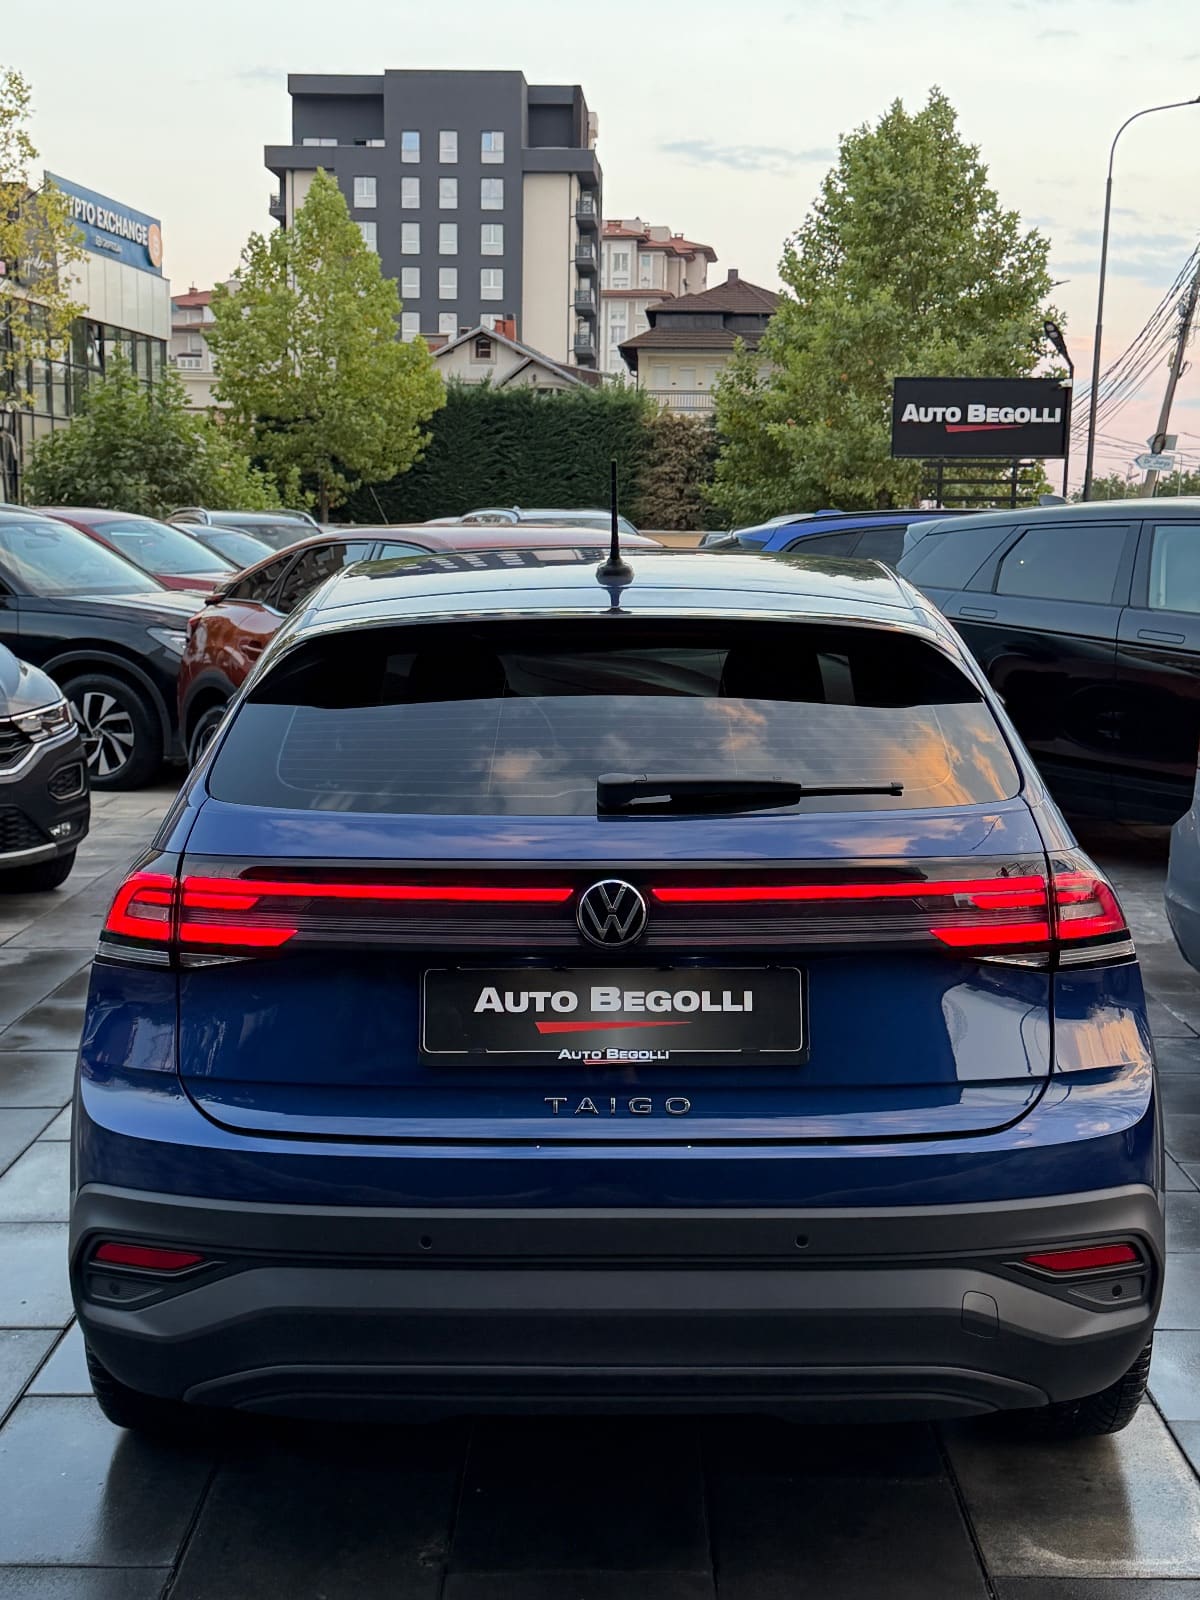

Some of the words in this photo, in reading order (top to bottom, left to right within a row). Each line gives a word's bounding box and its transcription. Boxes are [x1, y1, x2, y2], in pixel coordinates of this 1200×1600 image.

[96, 206, 149, 246] EXCHANGE
[901, 403, 962, 423] AUTO
[967, 404, 1062, 424] BEGOLLI
[474, 986, 579, 1013] AUTO
[590, 986, 753, 1013] BEGOLLI
[558, 1048, 602, 1060] AUTO
[606, 1048, 670, 1060] BEGOLLI
[544, 1097, 691, 1115] TAIGO
